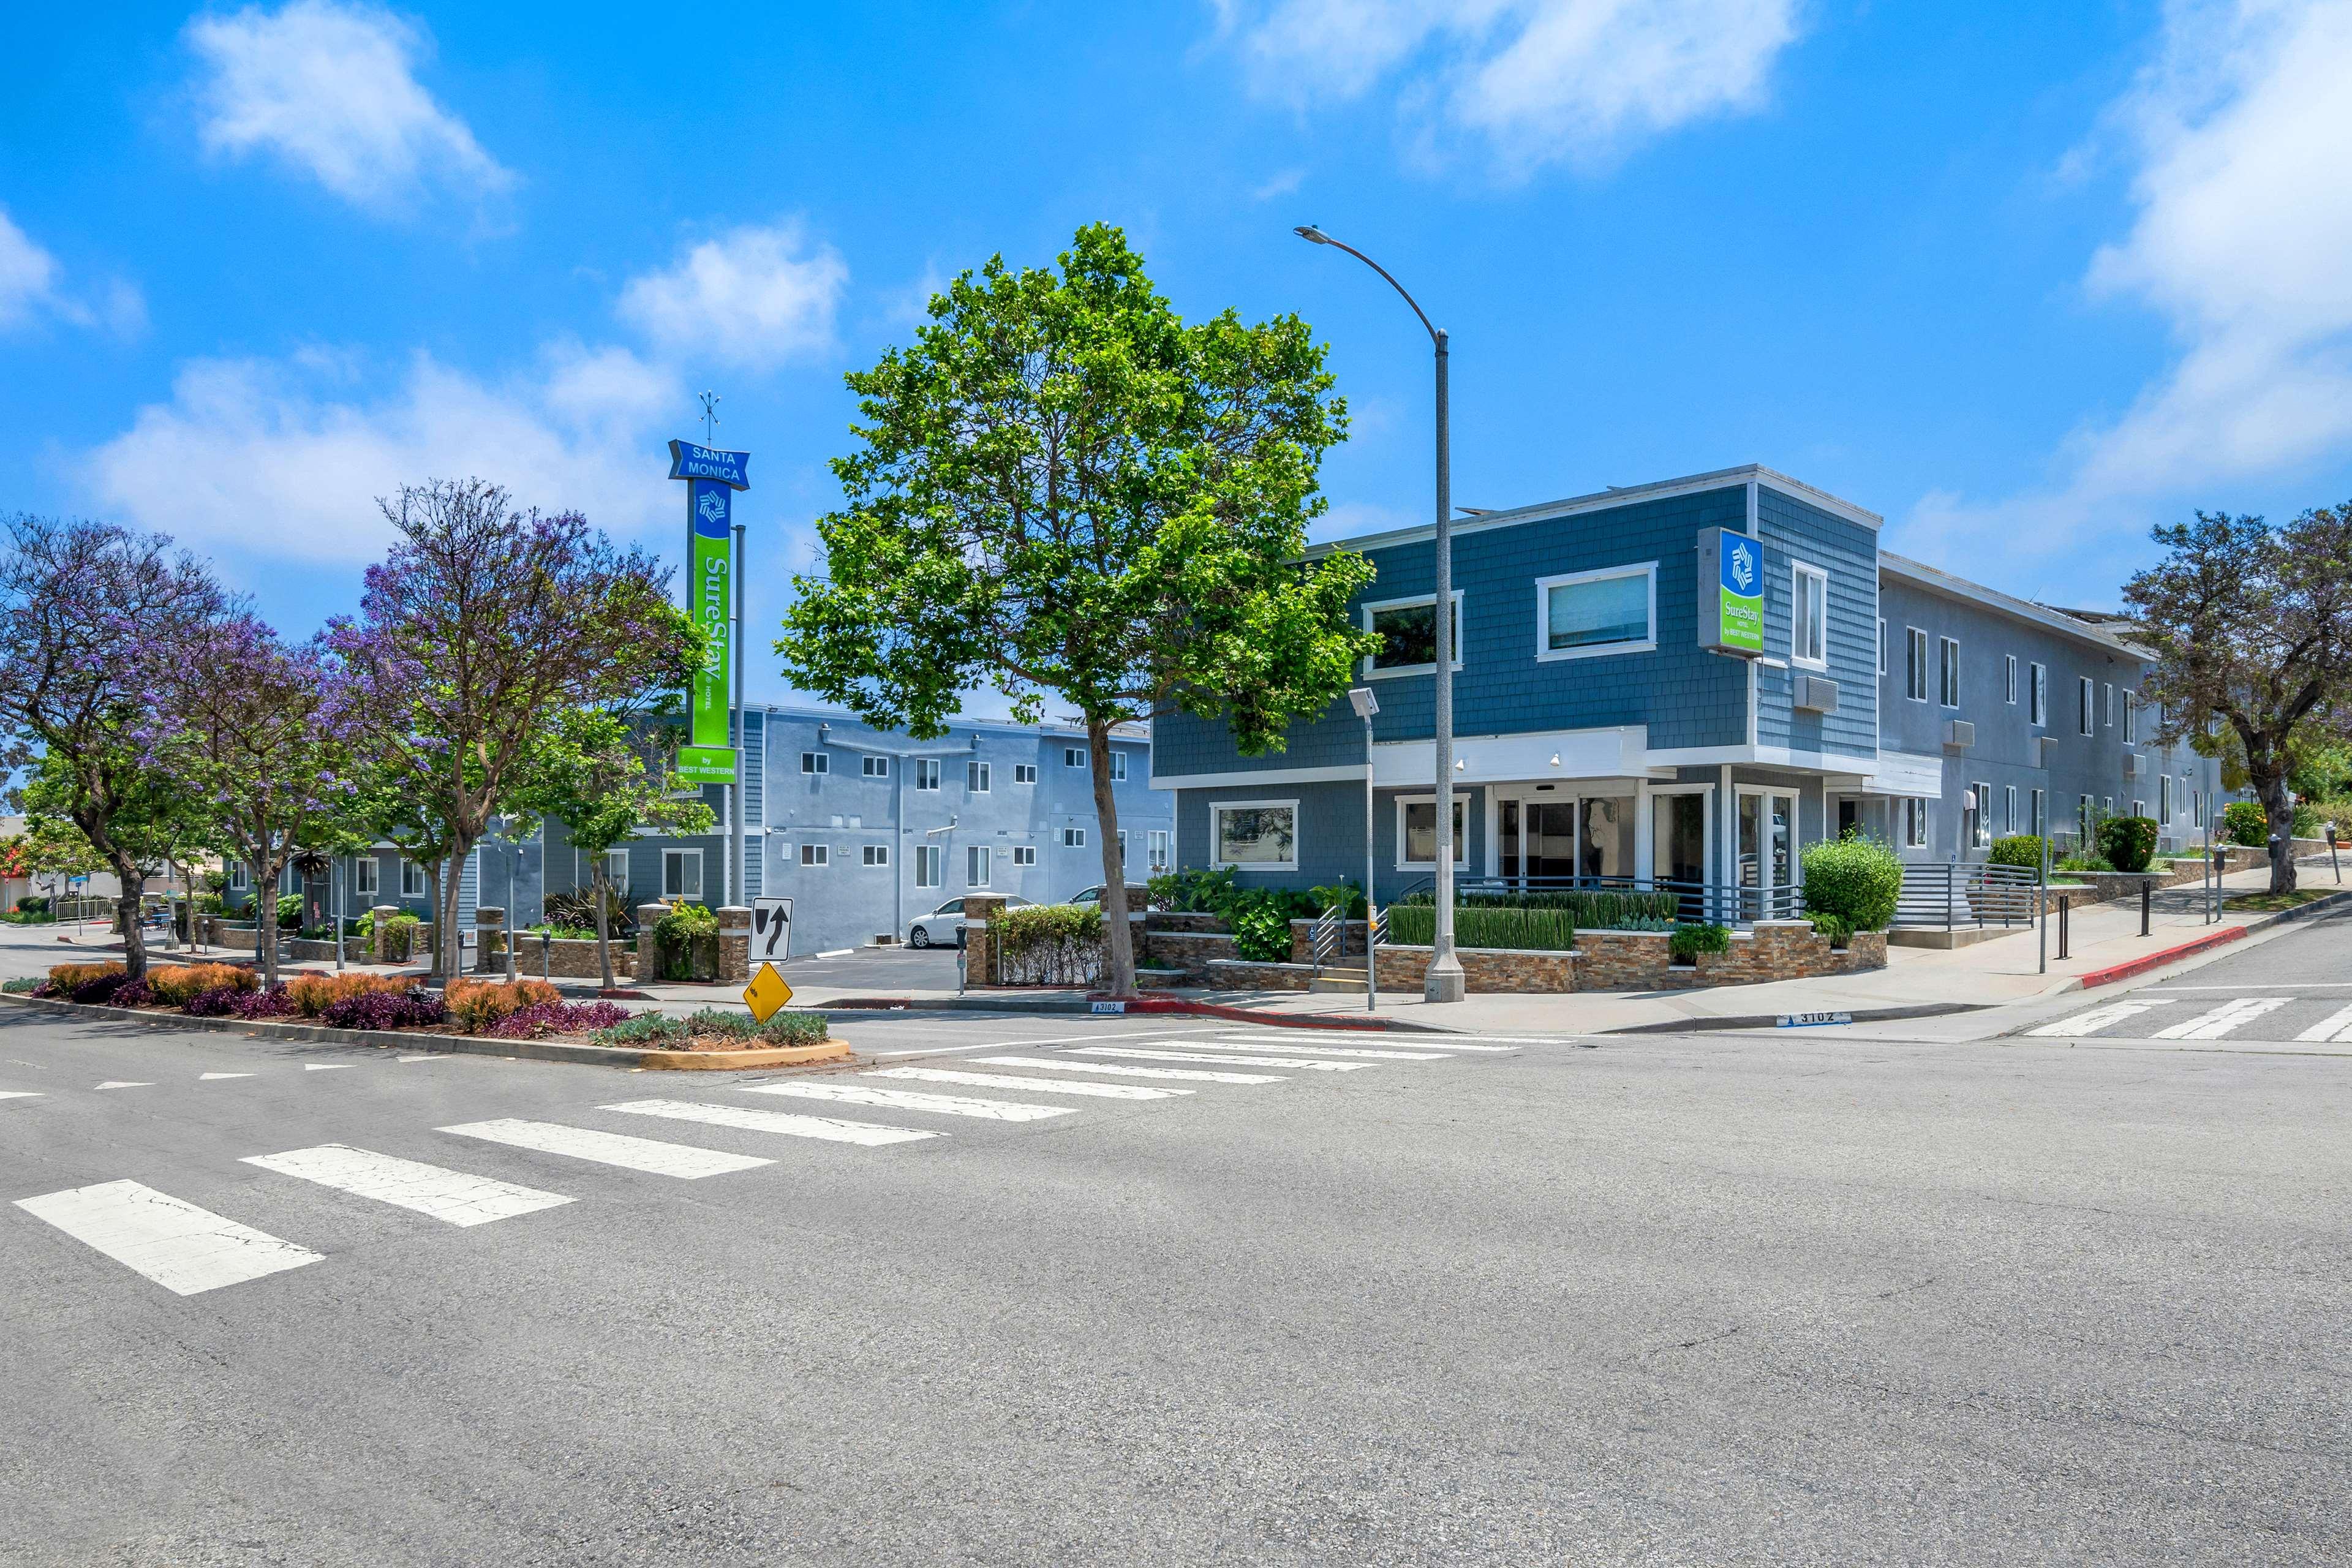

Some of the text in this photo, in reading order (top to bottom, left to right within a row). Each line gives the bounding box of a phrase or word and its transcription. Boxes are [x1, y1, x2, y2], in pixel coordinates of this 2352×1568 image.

[693, 447, 735, 464] SANTA
[688, 462, 740, 481] MONICA
[703, 557, 727, 680] SureStay
[1725, 601, 1758, 625] SureStay
[1801, 1012, 1834, 1022] 3102
